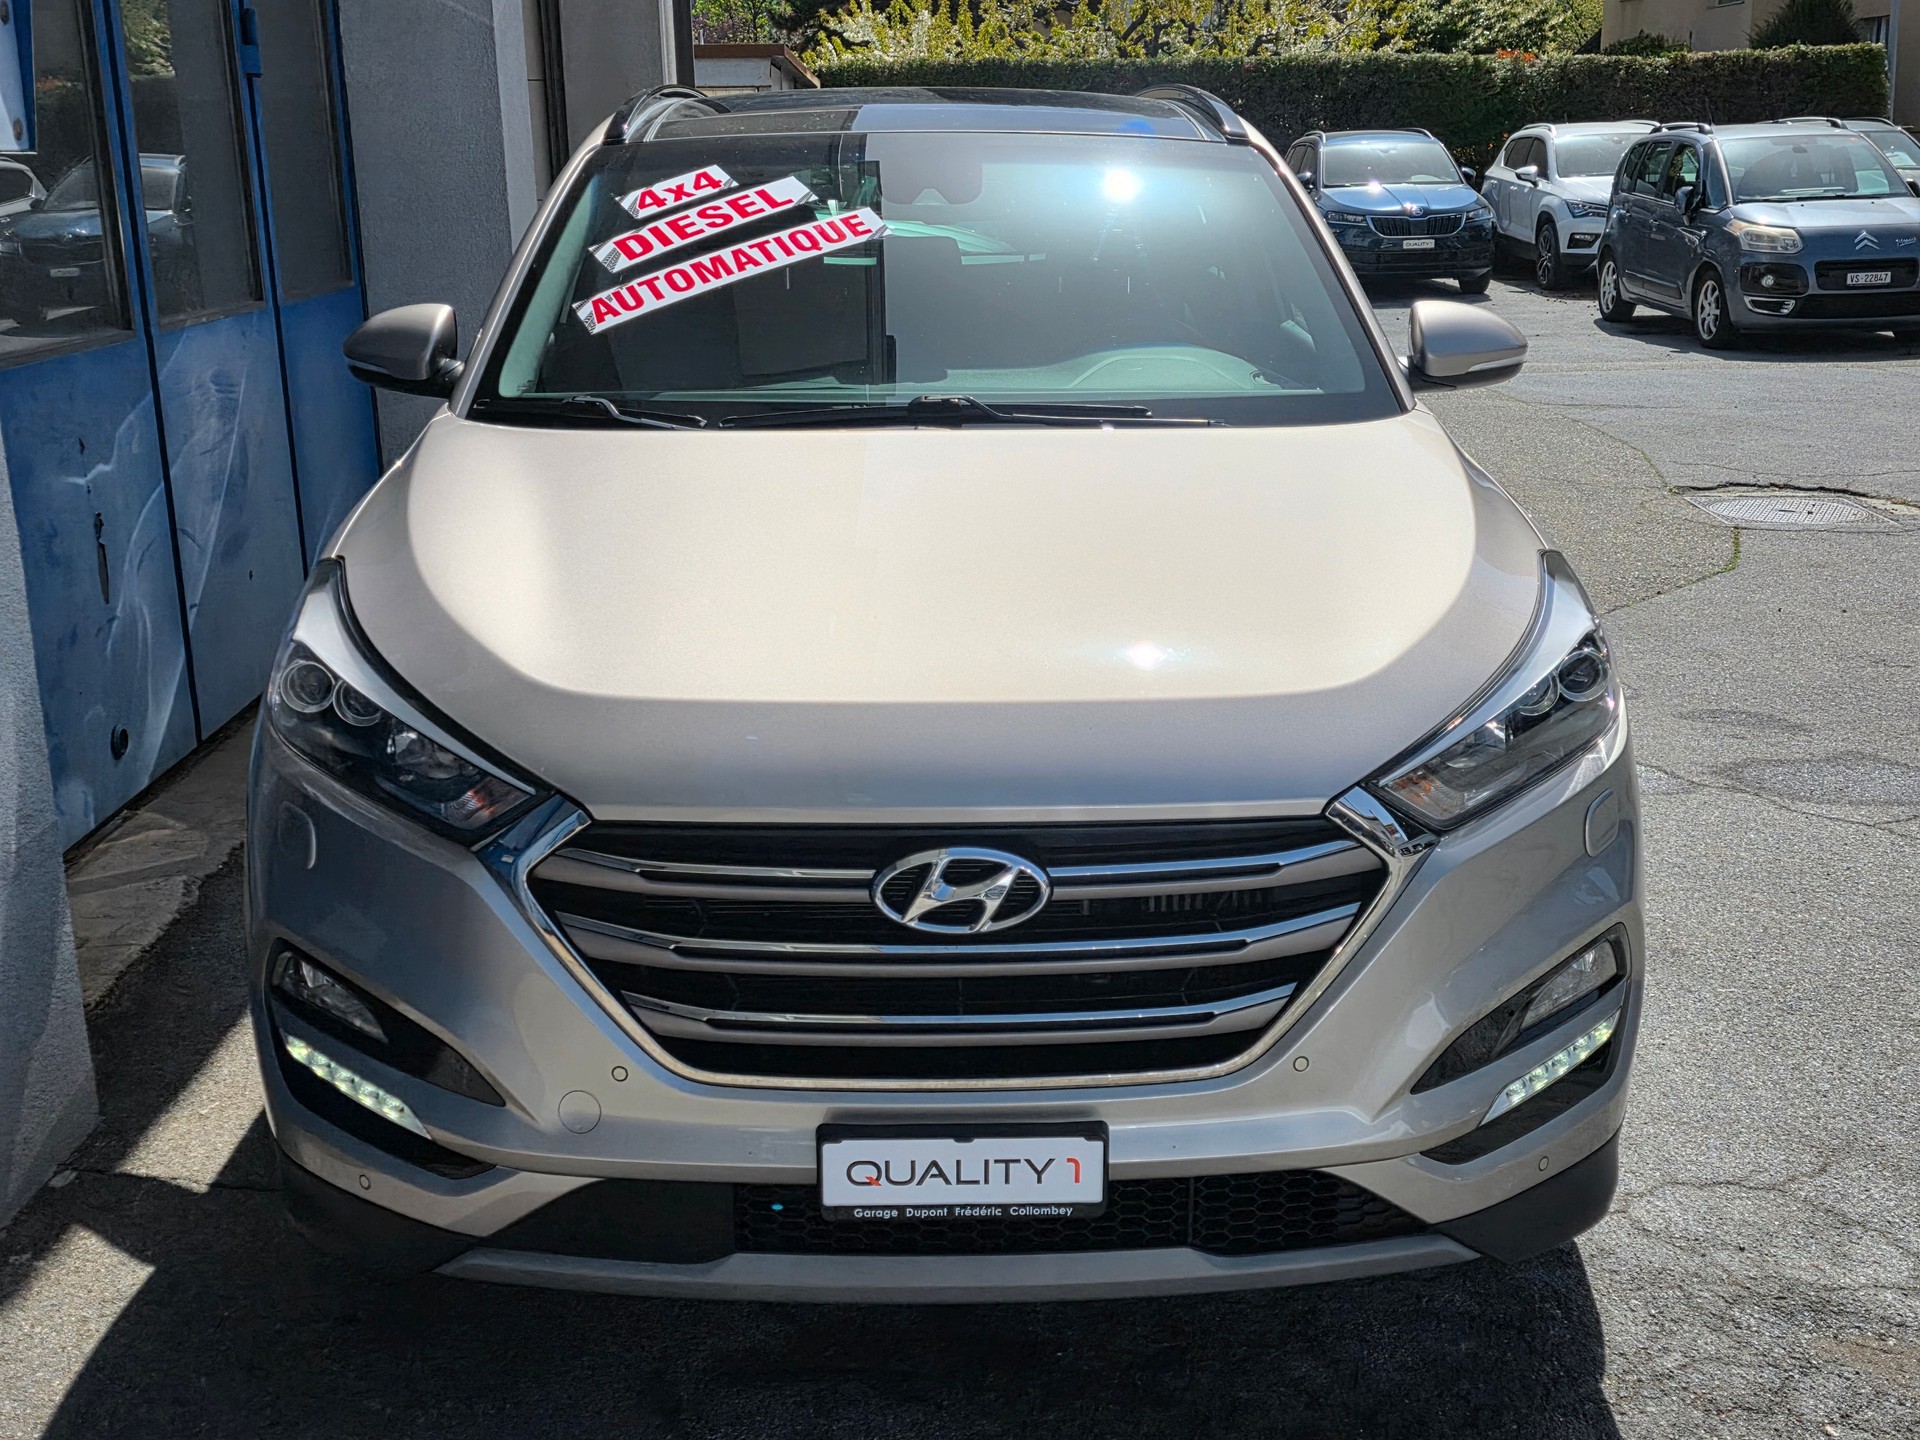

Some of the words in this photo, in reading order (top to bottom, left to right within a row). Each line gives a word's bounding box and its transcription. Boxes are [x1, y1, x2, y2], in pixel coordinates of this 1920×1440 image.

[636, 170, 723, 211] 4x4
[613, 188, 794, 261] DIESEL
[590, 213, 873, 325] AUTOMATIQUE
[846, 1158, 1055, 1186] QUALITY
[1066, 1157, 1080, 1183] 1
[854, 1208, 898, 1218] Garage
[906, 1207, 948, 1218] Dupont
[955, 1205, 1002, 1216] Frédéric
[1010, 1205, 1073, 1217] Collombey
